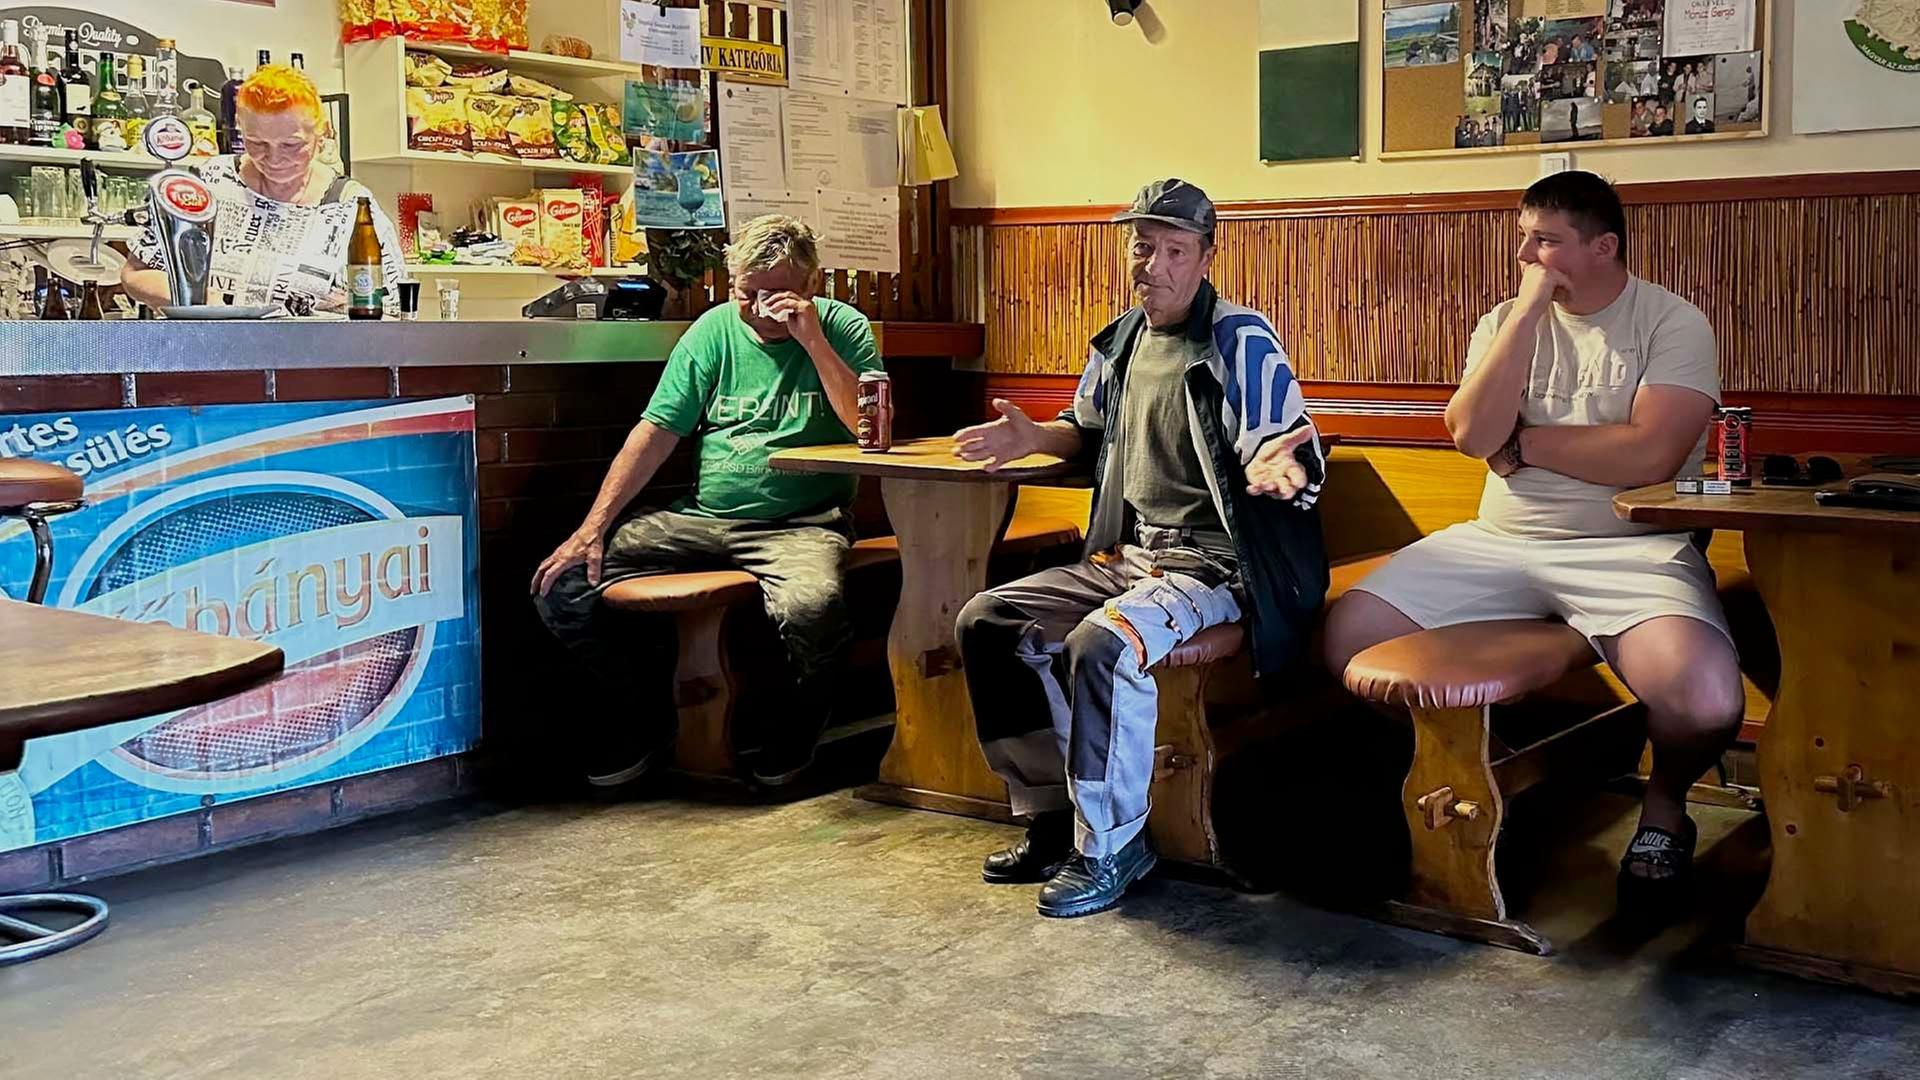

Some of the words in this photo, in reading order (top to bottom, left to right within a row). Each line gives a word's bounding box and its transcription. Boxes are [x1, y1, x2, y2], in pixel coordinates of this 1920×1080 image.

[78, 22, 122, 48] Quality
[719, 47, 783, 74] KATEGÓRIA
[54, 423, 172, 477] sülés
[115, 525, 433, 639] bányai
[1639, 831, 1672, 849] NIKE
